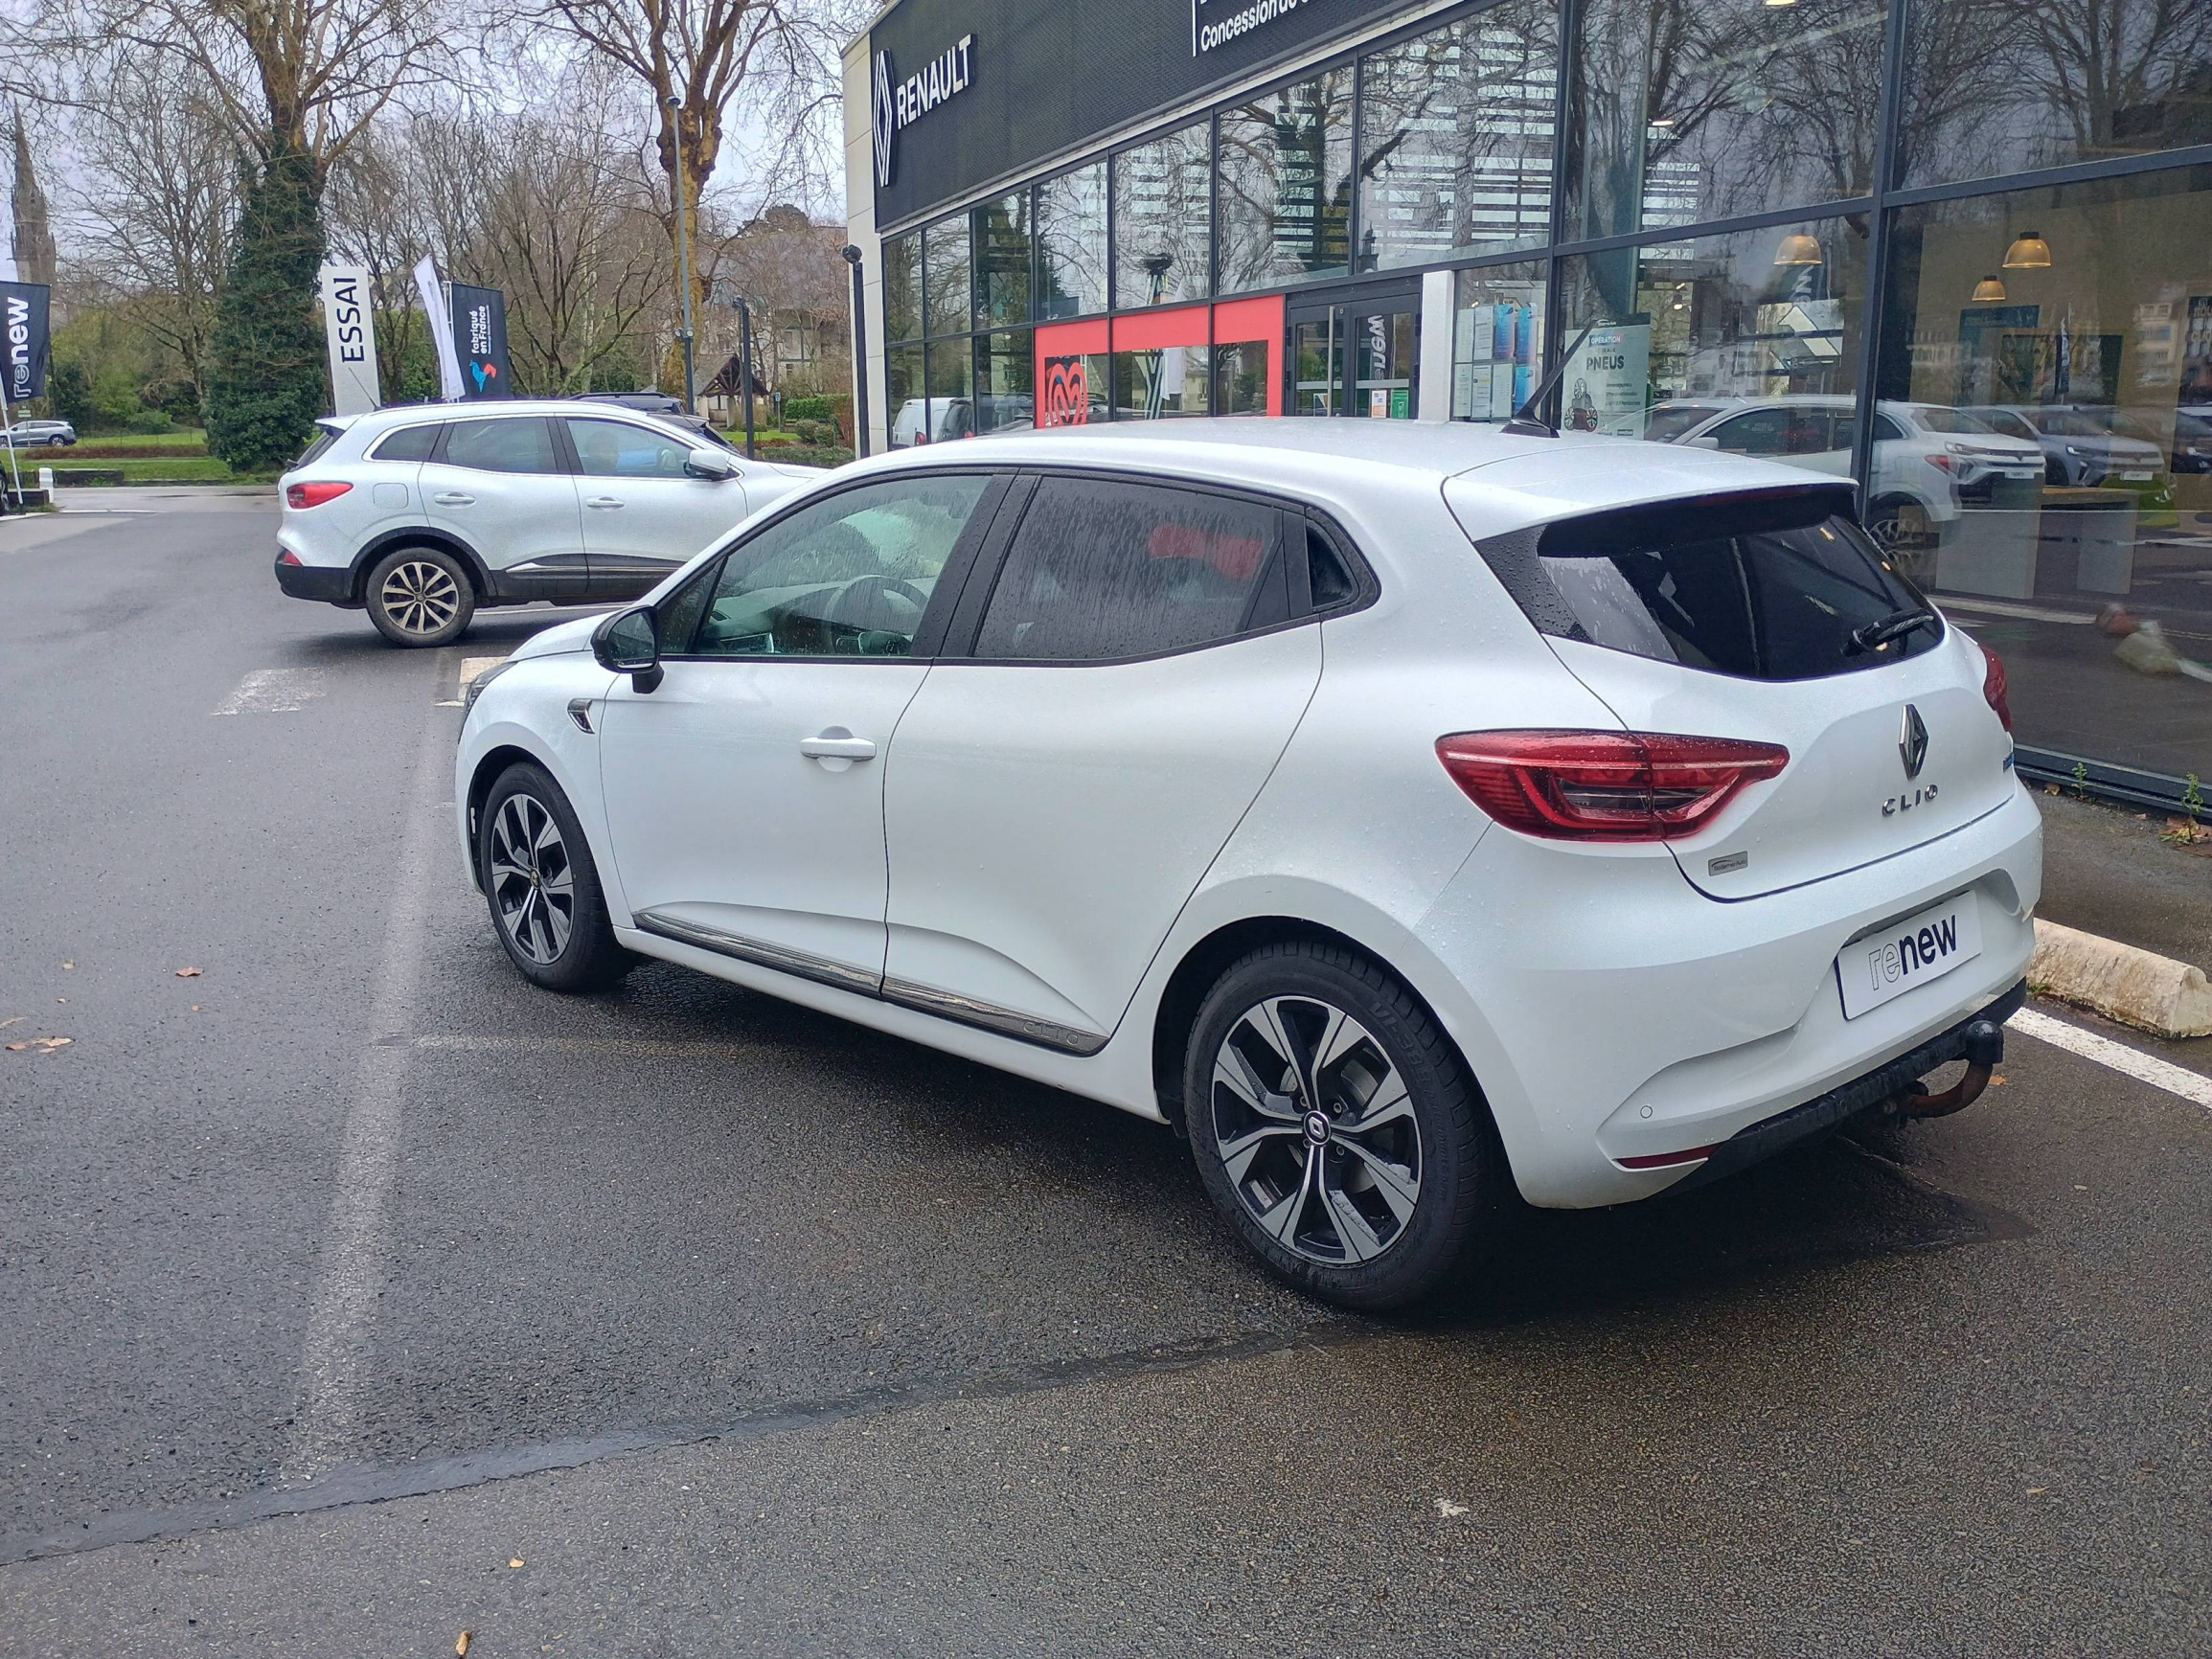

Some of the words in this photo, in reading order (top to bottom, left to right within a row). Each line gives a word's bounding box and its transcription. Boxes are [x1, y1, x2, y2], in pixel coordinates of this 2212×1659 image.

[1200, 0, 1277, 52] Concession
[897, 34, 971, 130] RENAULT
[332, 277, 365, 363] ESSAI
[468, 310, 480, 354] fabriqué
[7, 296, 32, 398] renew
[480, 341, 488, 354] en
[1585, 354, 1625, 371] PNEUS
[1881, 784, 1939, 817] CLIO
[1868, 914, 1957, 991] renew
